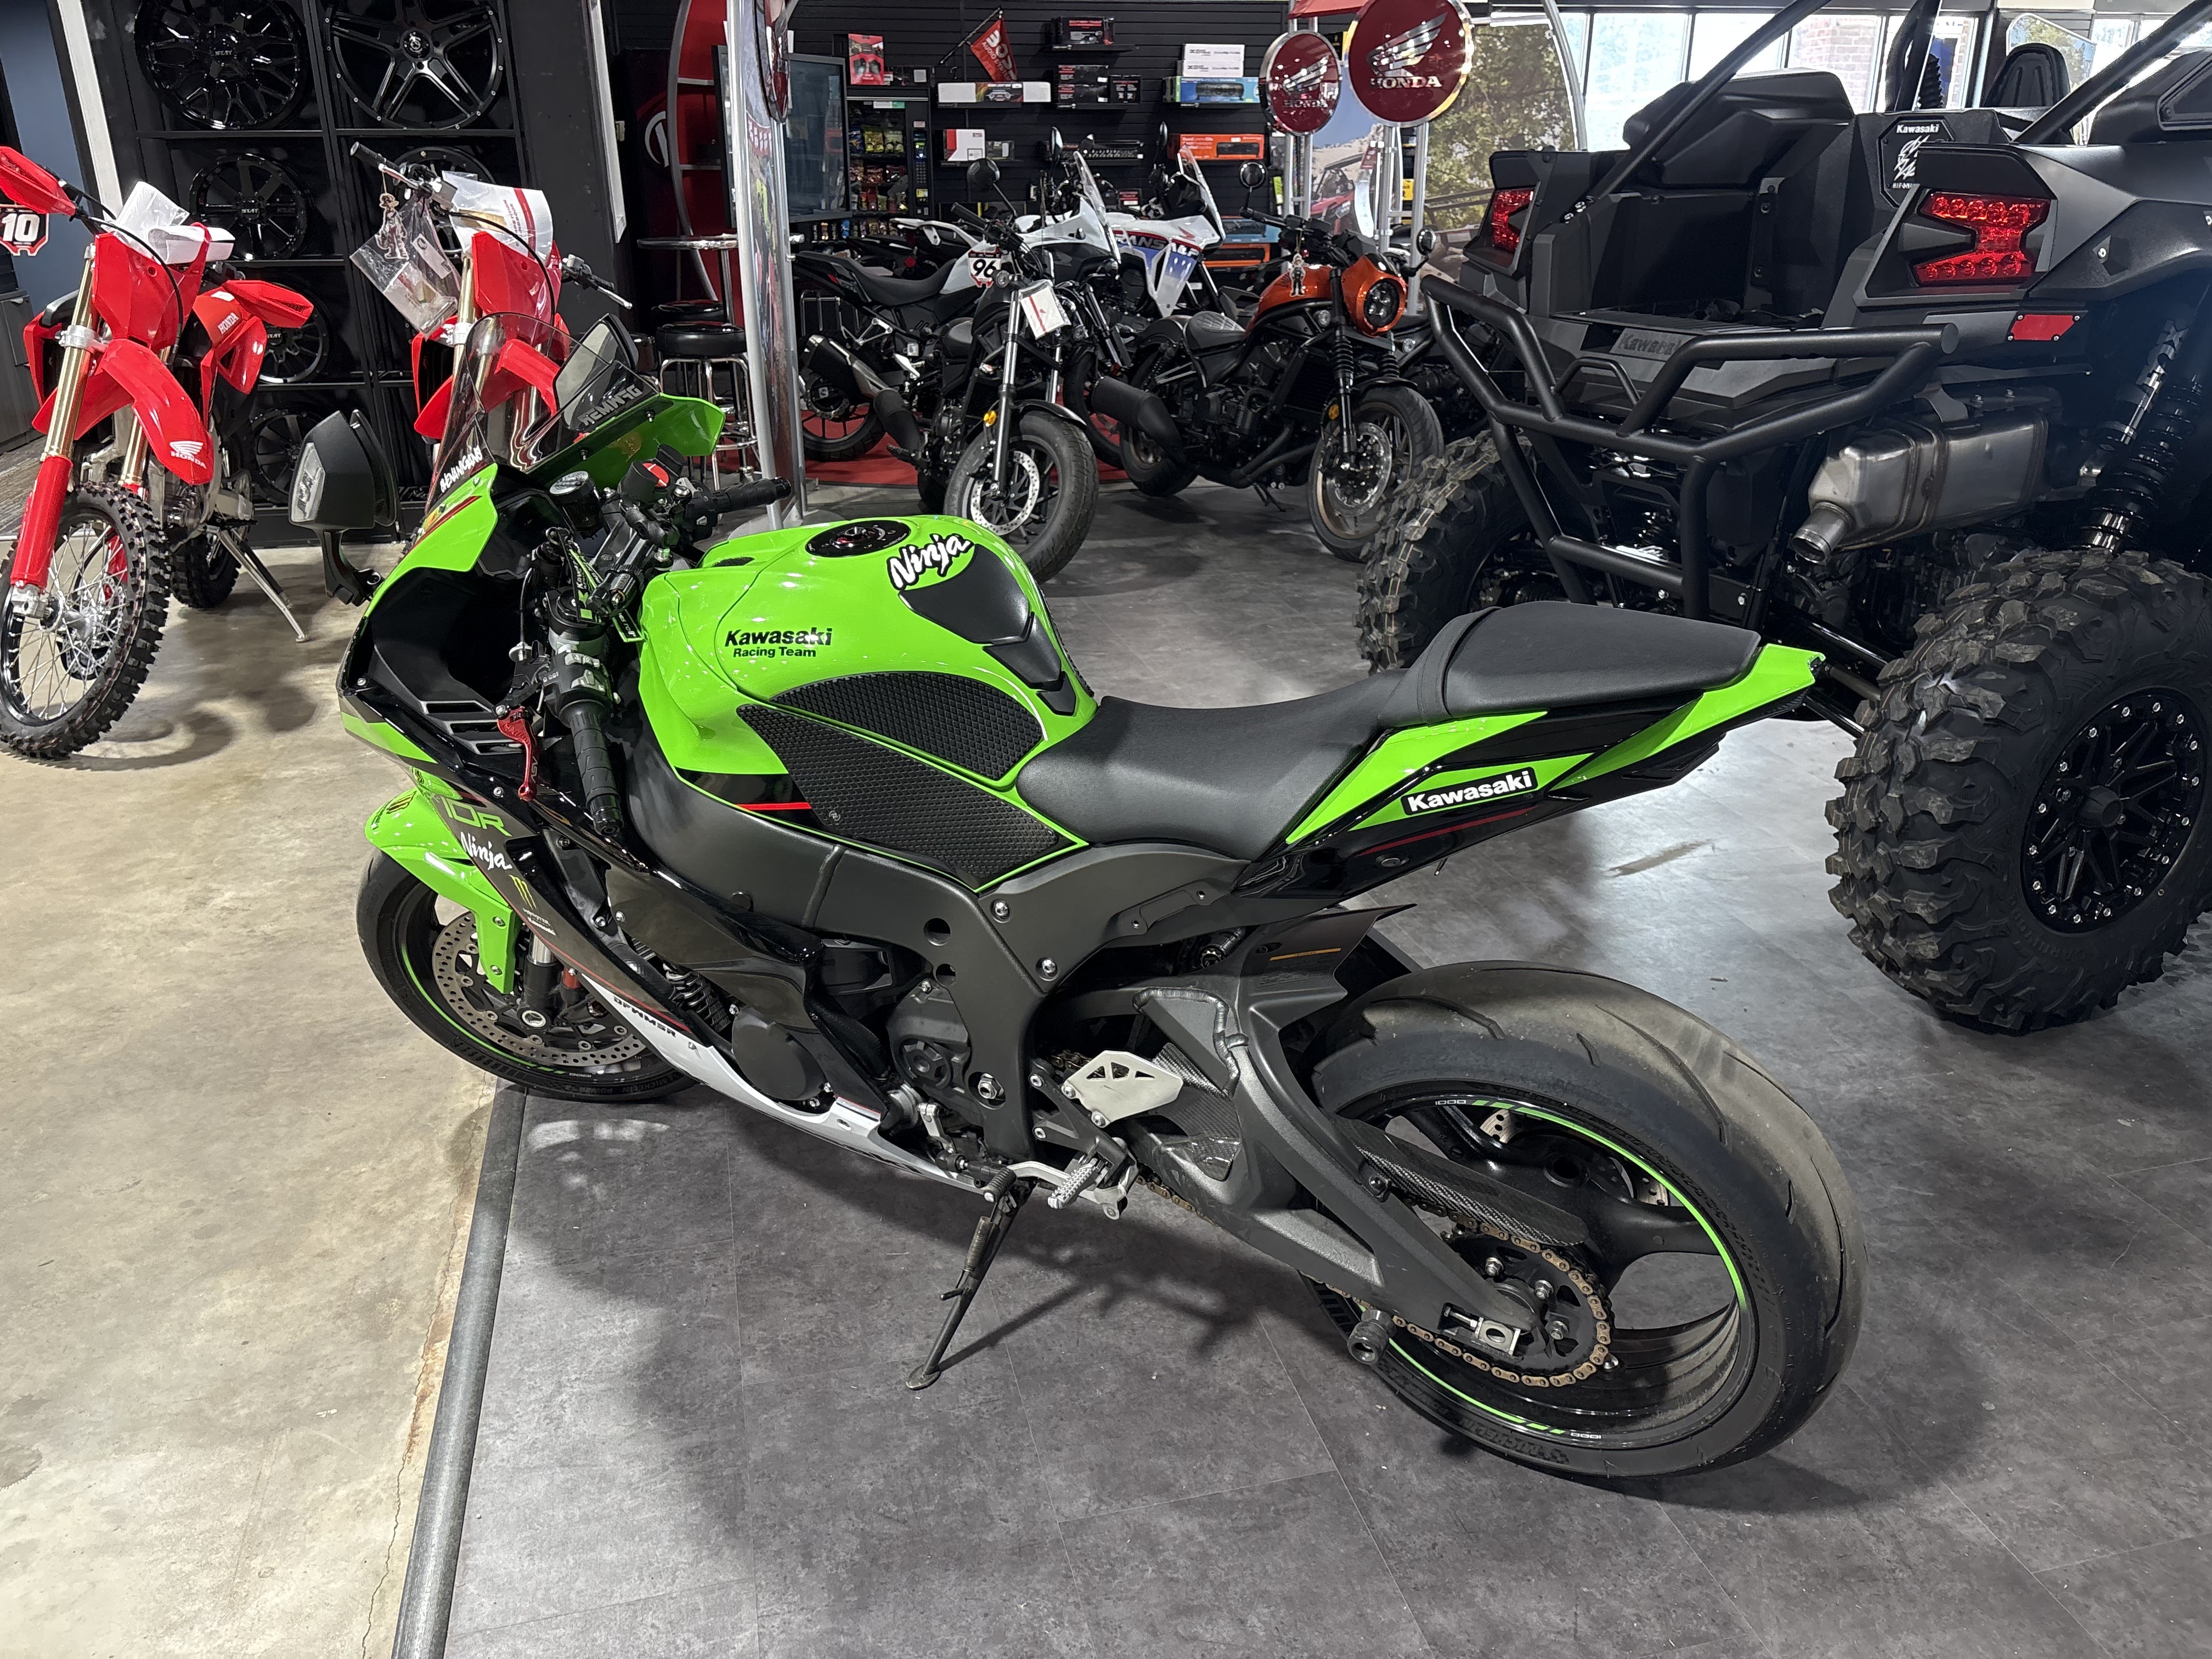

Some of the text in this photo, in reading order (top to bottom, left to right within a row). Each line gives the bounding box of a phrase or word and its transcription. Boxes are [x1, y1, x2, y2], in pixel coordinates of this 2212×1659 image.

[1371, 76, 1442, 89] HONDA
[1896, 123, 1939, 133] Kawasaki
[2, 213, 40, 241] 10
[973, 258, 997, 278] 96
[217, 312, 239, 335] HONDA
[170, 450, 207, 470] HONDA
[888, 533, 974, 590] Ninja
[725, 627, 833, 647] Kawasaki
[733, 646, 816, 658] Racing Team
[1407, 770, 1532, 812] Kawasaki
[460, 832, 513, 870] Ninja
[613, 996, 676, 1038] DFWMSR
